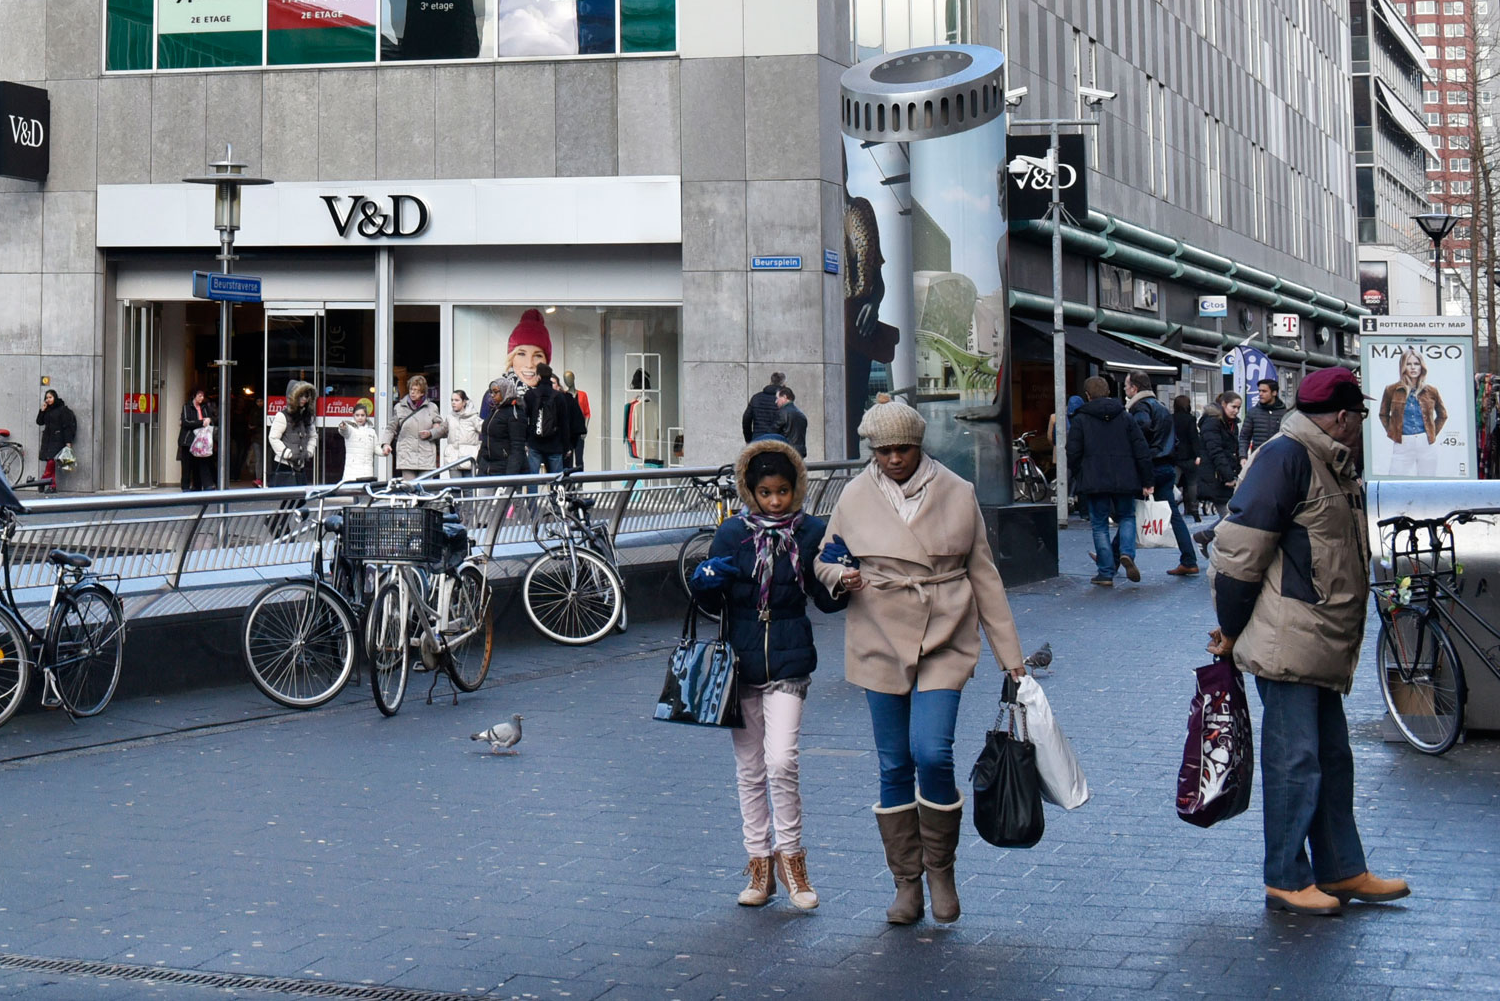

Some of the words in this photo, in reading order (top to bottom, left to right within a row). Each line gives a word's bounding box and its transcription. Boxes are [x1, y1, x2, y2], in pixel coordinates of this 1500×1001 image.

[430, 1, 454, 12] etage
[190, 16, 201, 24] 2E
[204, 15, 231, 23] ETAGE
[315, 10, 344, 19] ETAGE
[8, 114, 44, 148] V&D
[319, 194, 432, 239] V&D
[754, 258, 798, 268] Beursplein
[213, 278, 258, 293] Beurstraverse
[1283, 316, 1297, 333] T
[326, 402, 354, 414] finale
